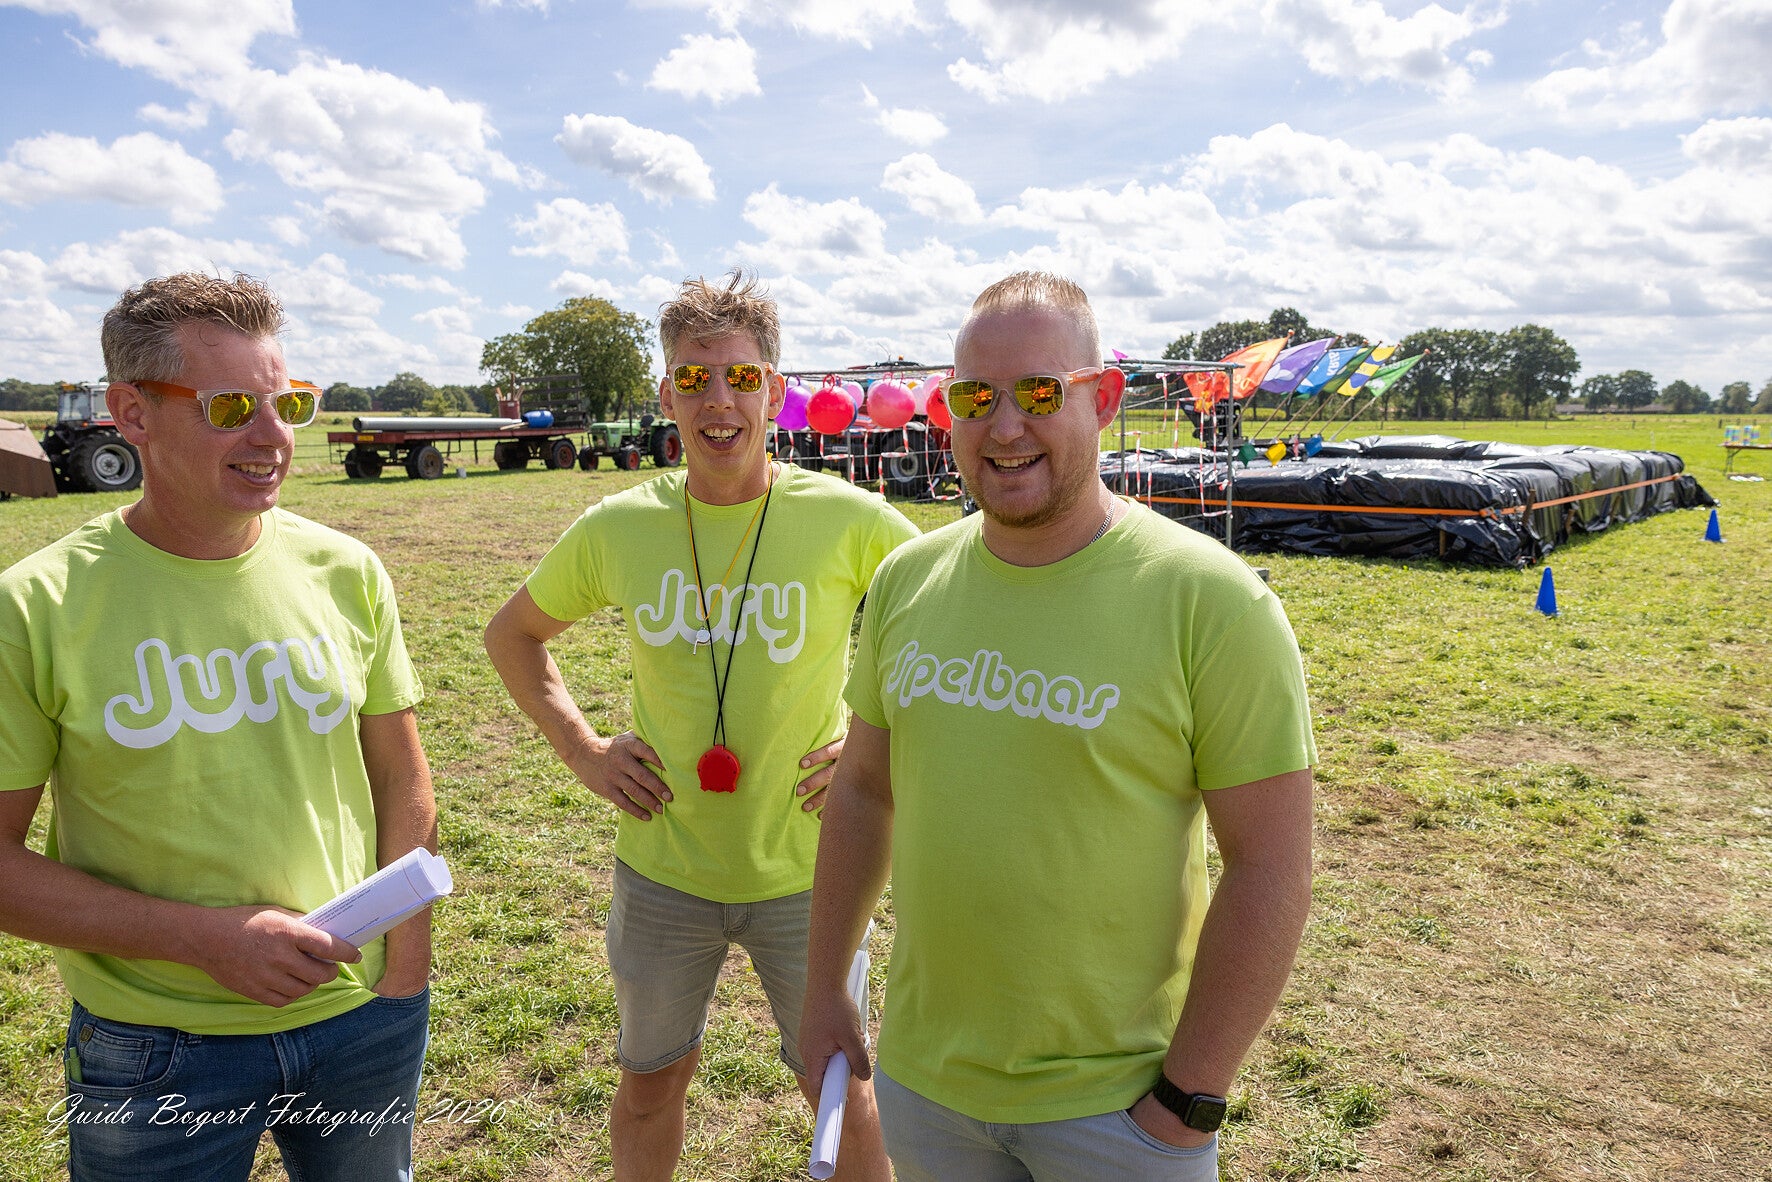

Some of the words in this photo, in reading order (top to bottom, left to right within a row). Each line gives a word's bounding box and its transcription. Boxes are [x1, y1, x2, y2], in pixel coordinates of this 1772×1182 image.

[634, 568, 806, 664] Jury
[104, 633, 351, 748] Jury
[886, 640, 1120, 729] Spelbaas
